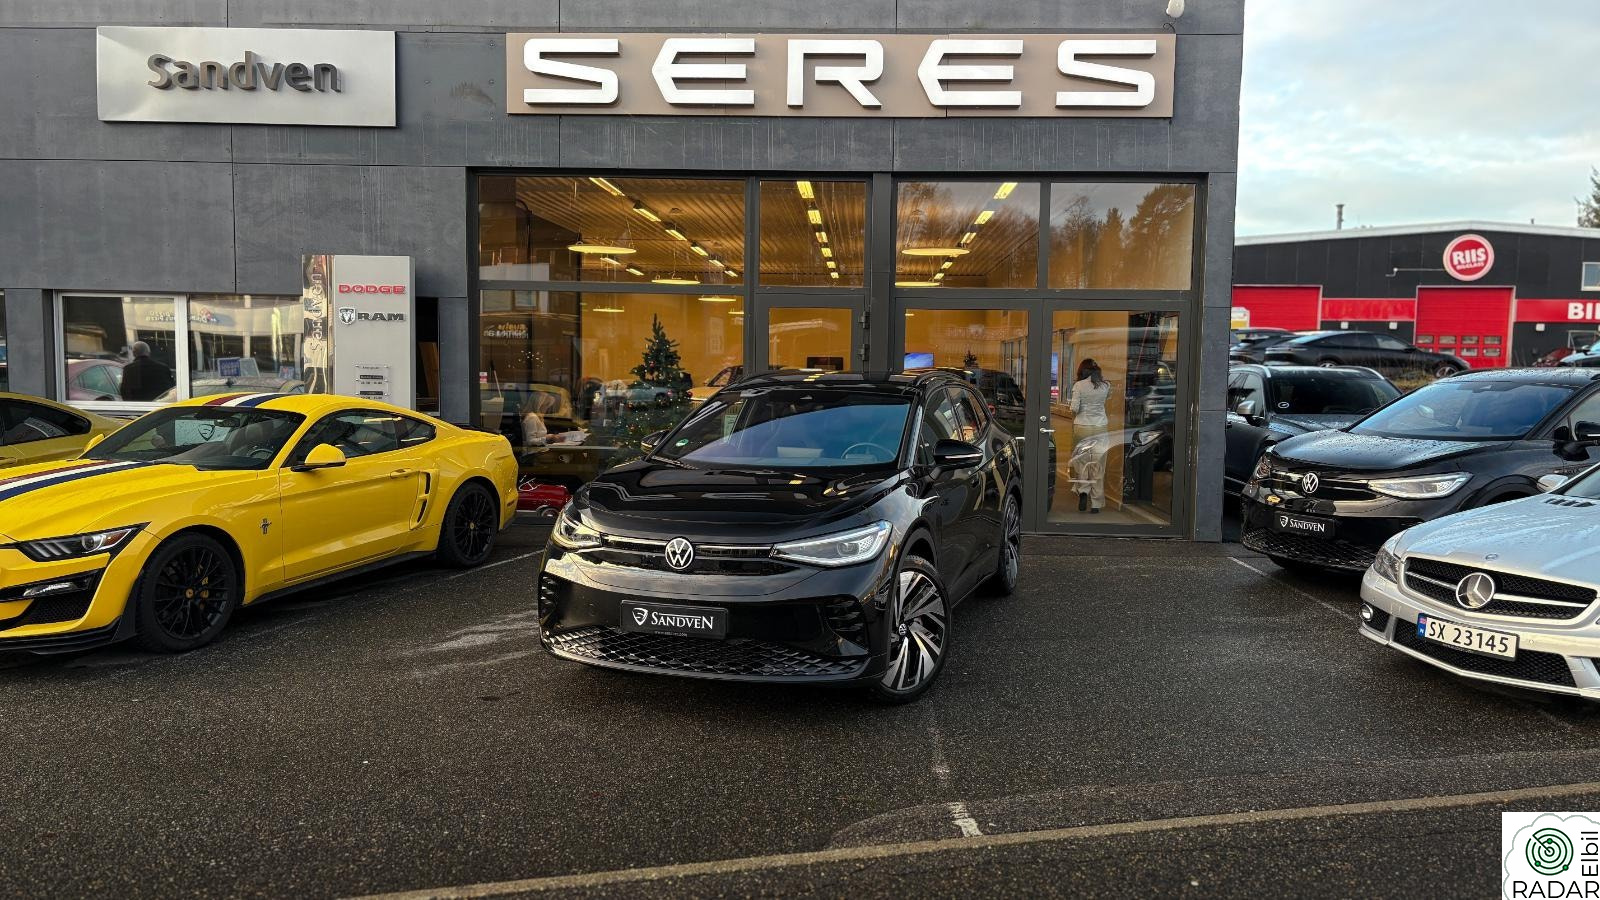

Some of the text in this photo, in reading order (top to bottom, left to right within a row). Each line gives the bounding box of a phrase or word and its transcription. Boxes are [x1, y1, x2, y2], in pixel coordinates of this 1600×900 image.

[147, 50, 342, 93] Sandven
[523, 38, 1158, 108] SERES
[1452, 247, 1486, 266] RIIS
[338, 284, 406, 295] DODGE
[357, 312, 405, 322] RAM
[651, 611, 714, 630] SANDVEN
[1429, 621, 1446, 640] SX
[1453, 627, 1509, 653] 23145
